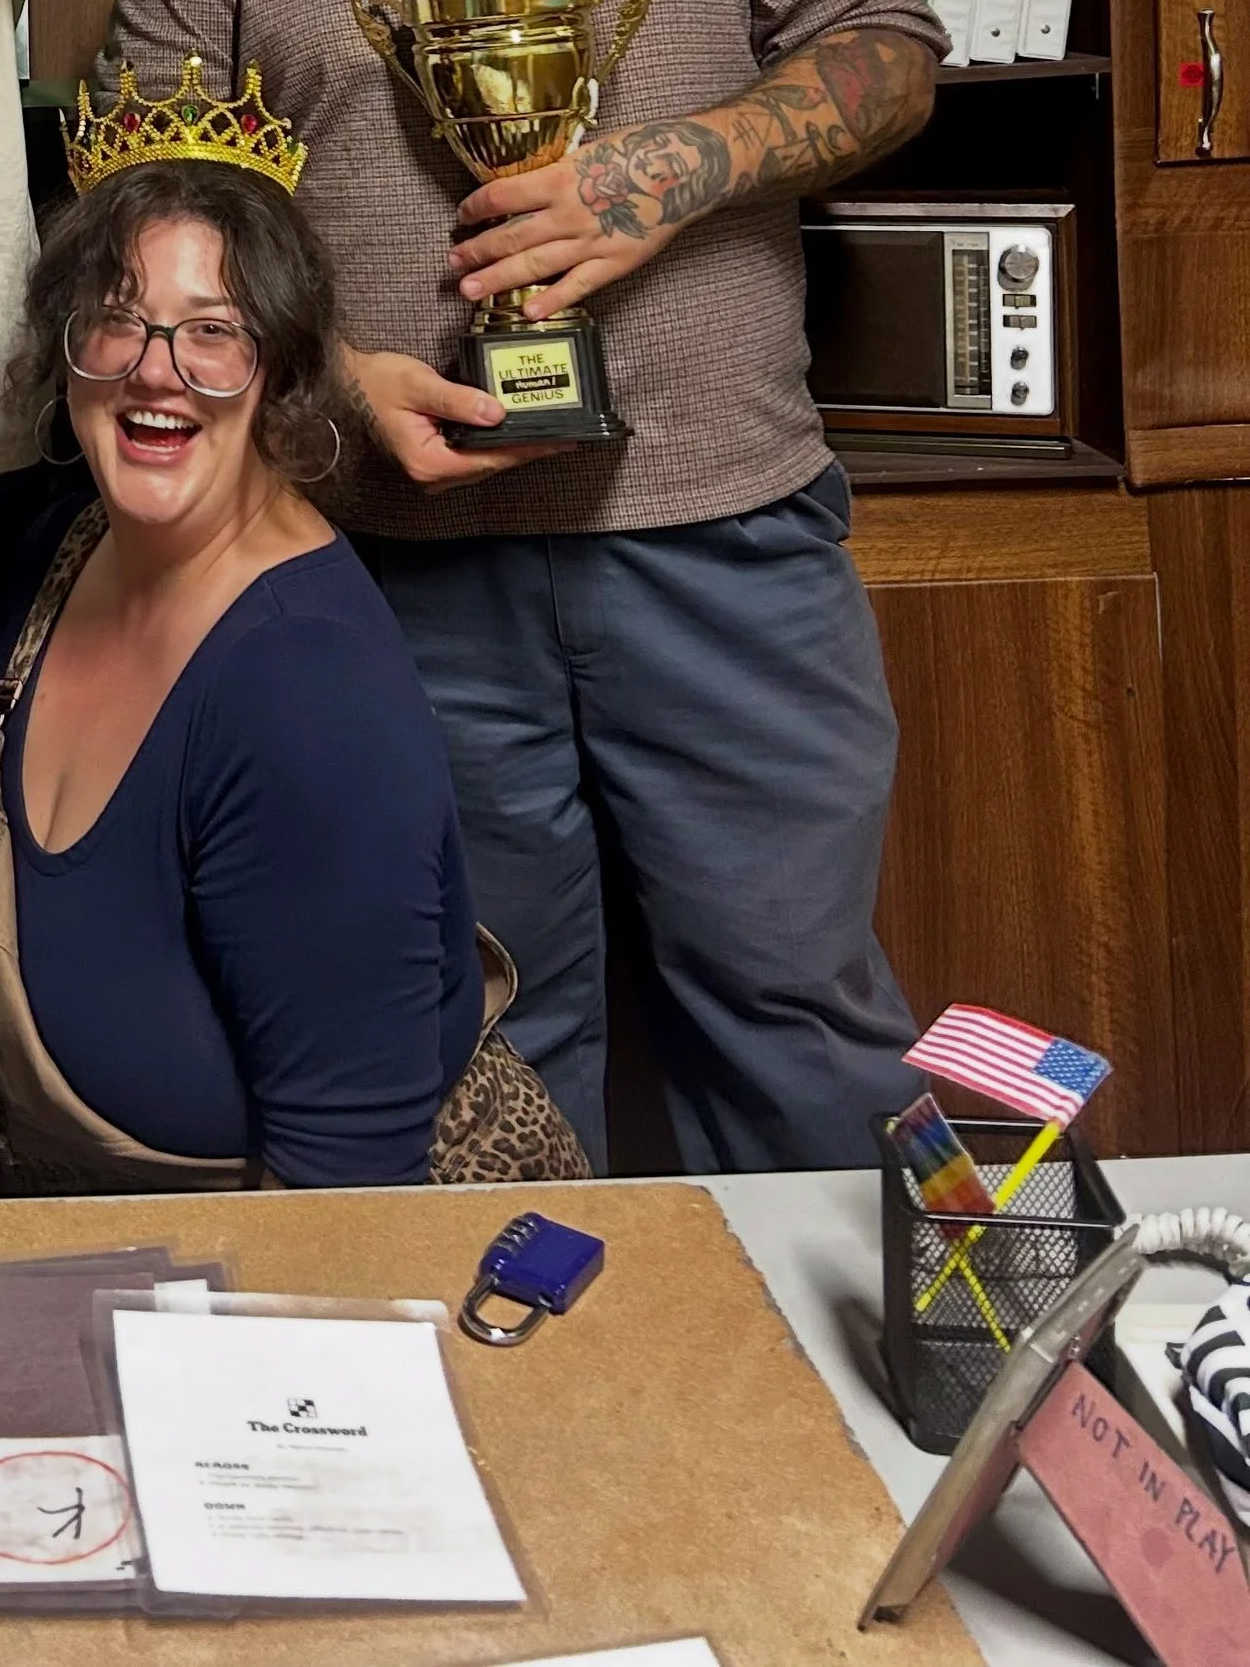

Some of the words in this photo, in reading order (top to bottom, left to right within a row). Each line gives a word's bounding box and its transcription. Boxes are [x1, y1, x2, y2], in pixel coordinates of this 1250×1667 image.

[518, 354, 544, 365] THE
[499, 364, 568, 380] ULTIMATE
[512, 389, 564, 404] GENIUS
[246, 1420, 279, 1432] The
[283, 1422, 367, 1436] Crossword
[1071, 1393, 1131, 1459] NOT
[1138, 1460, 1166, 1503] IN
[1175, 1497, 1236, 1574] PLAY
